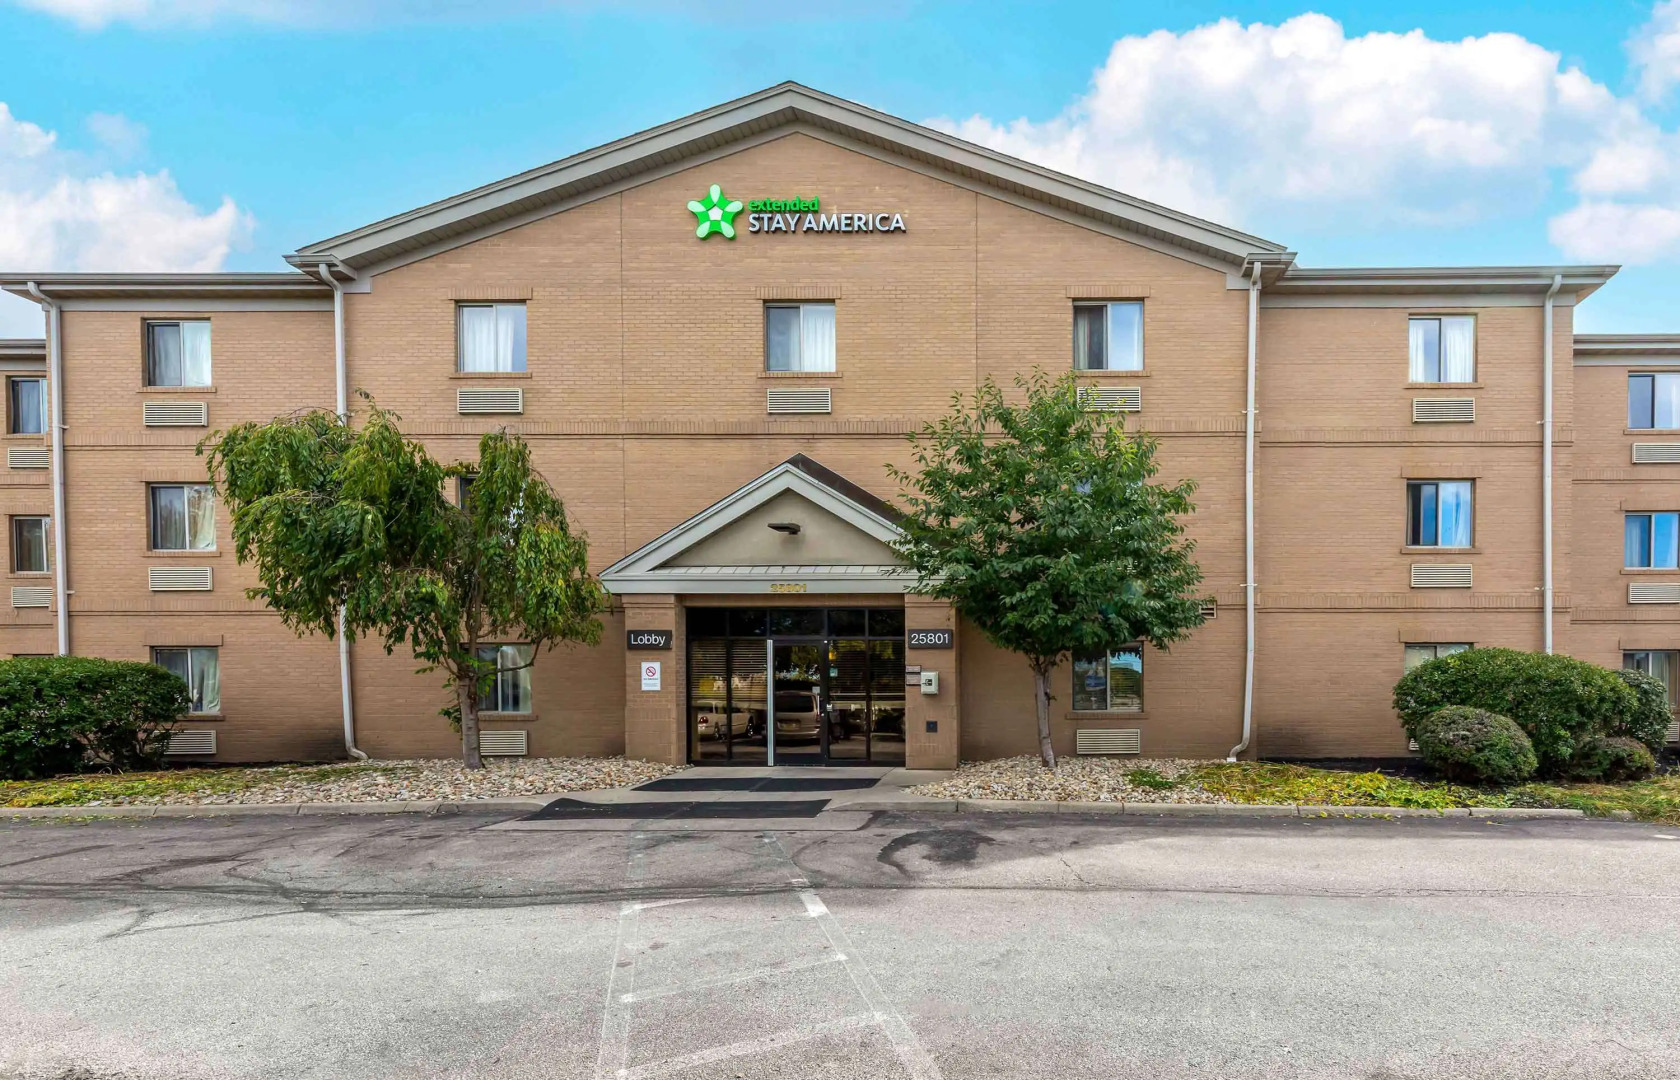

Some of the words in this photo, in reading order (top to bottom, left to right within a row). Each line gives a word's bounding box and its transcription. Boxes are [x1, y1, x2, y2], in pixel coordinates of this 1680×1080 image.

[748, 196, 819, 212] extended
[748, 213, 801, 233] STAY
[802, 213, 906, 233] AMERICA
[631, 633, 666, 647] Lobby
[911, 633, 949, 644] 25801
